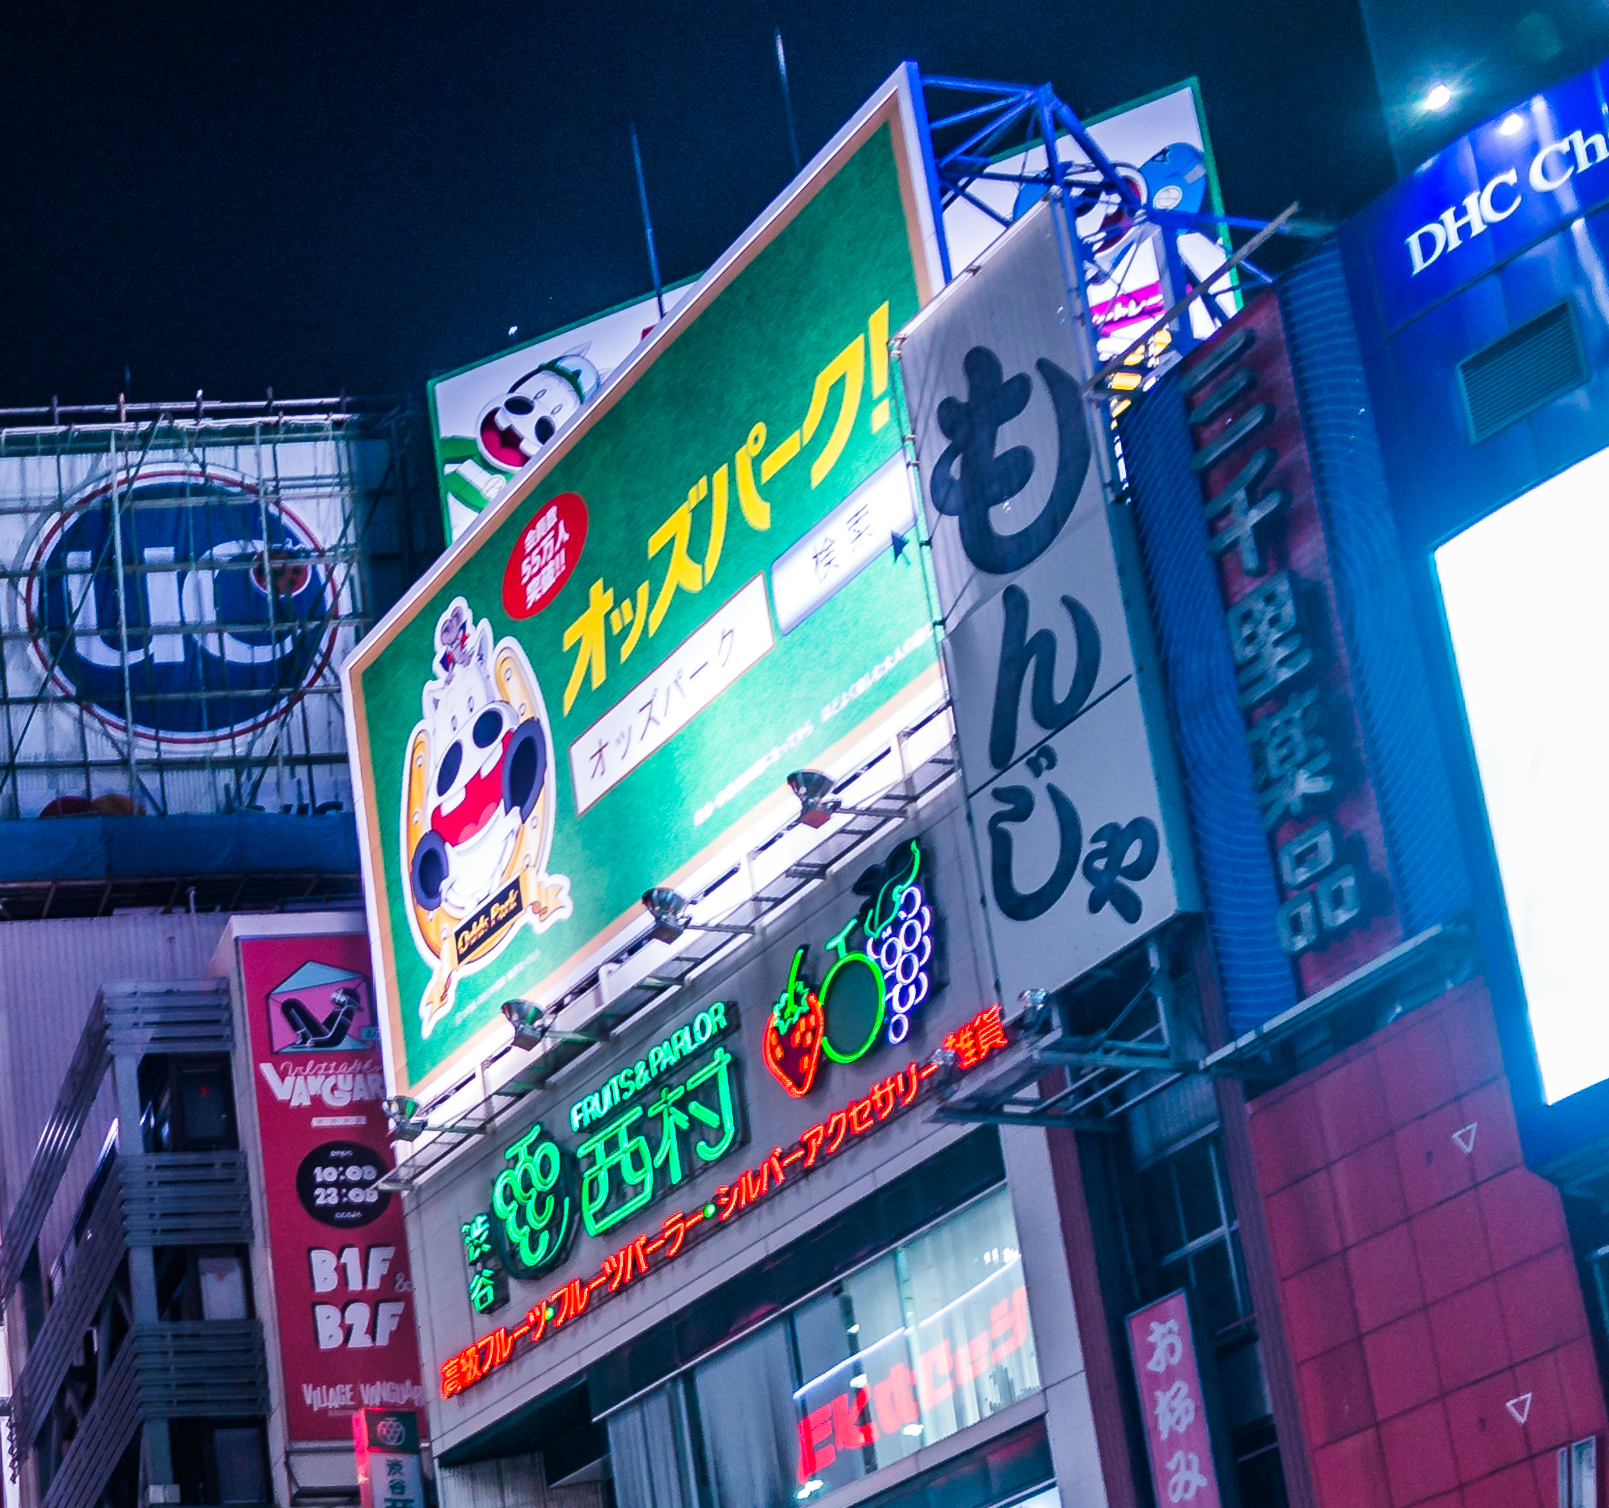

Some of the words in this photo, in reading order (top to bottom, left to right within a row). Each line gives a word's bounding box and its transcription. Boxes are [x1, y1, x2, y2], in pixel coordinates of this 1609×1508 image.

[1403, 172, 1522, 278] DHC
[562, 300, 890, 717] オッズパーク!
[811, 502, 873, 585] 検索
[930, 346, 1160, 925] もんじゃ
[588, 626, 737, 780] オッズパーク
[464, 1213, 495, 1314] 渋谷
[576, 1047, 735, 1238] 西村
[310, 1246, 395, 1293] B1F
[315, 1301, 405, 1351] B2F
[302, 1383, 355, 1409] VILLAGE
